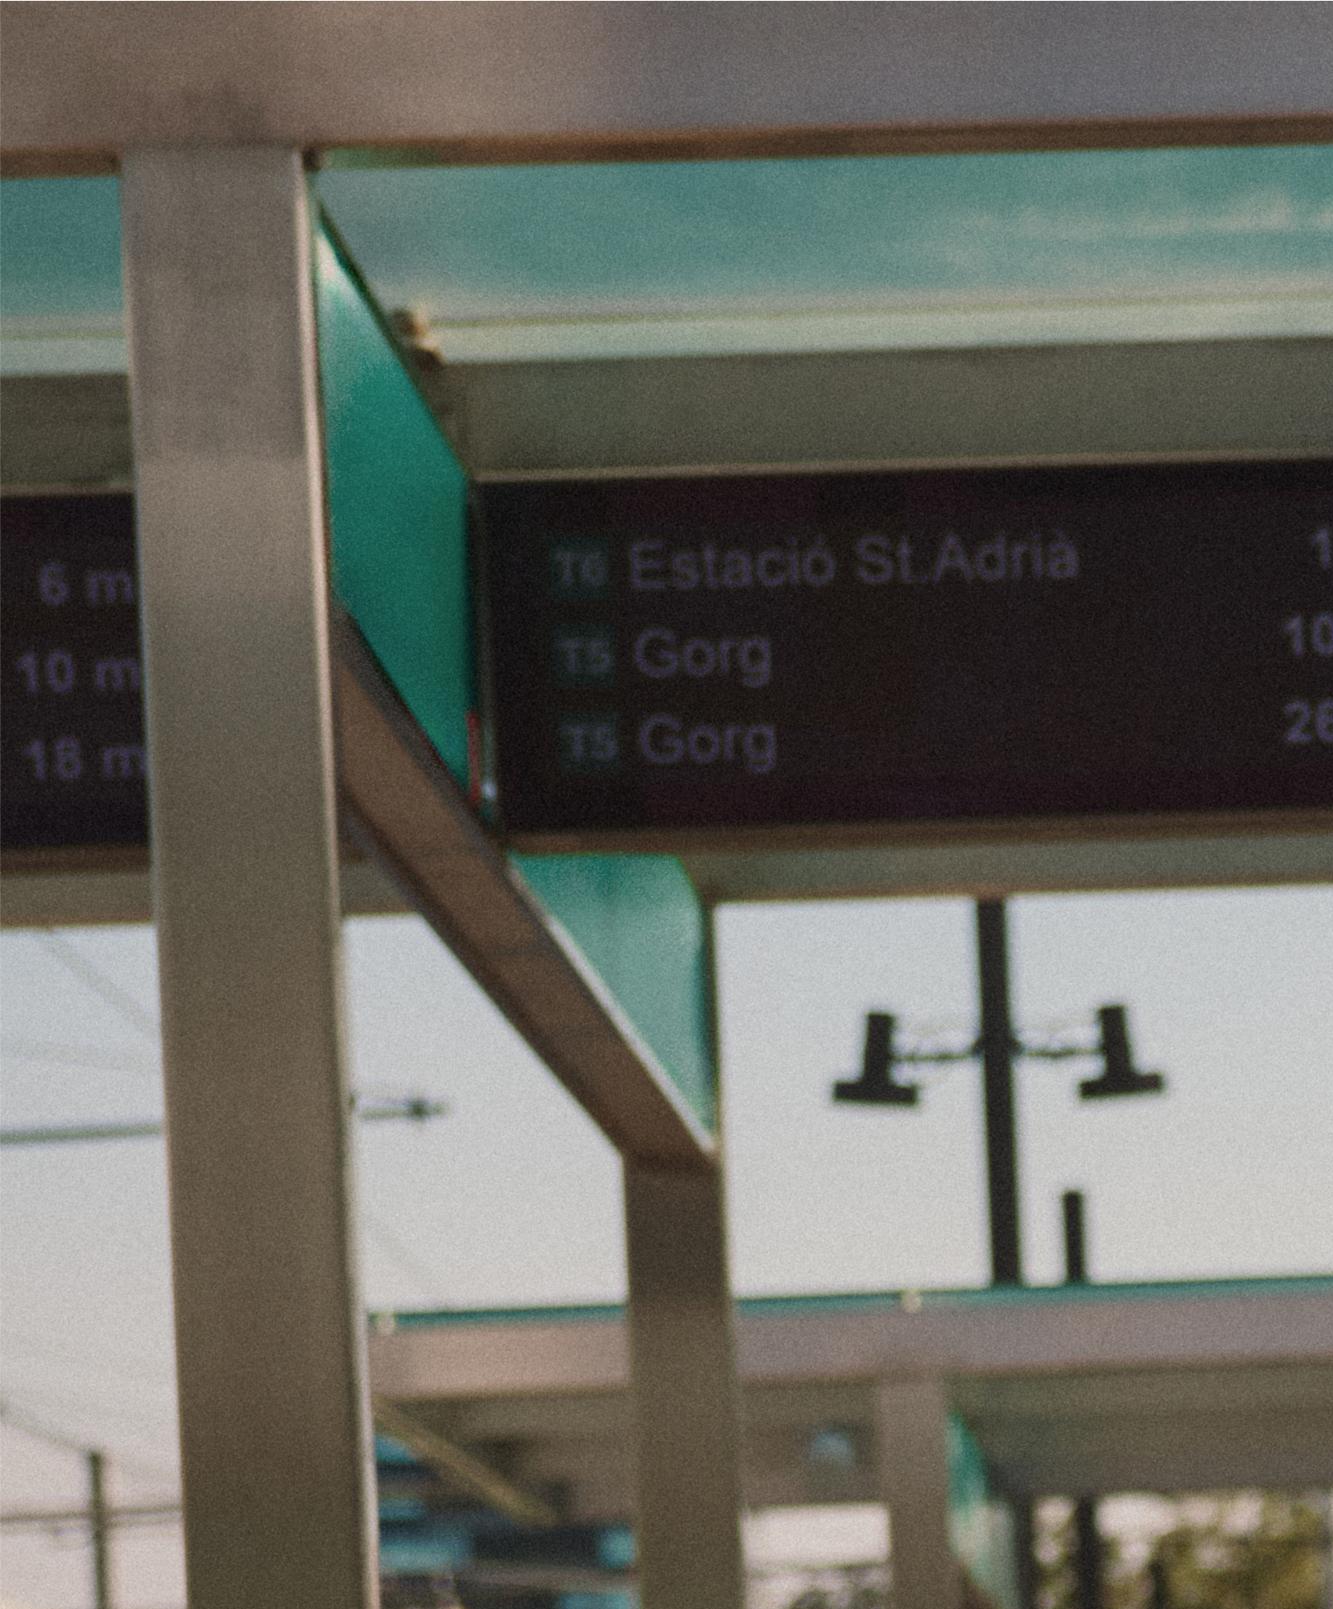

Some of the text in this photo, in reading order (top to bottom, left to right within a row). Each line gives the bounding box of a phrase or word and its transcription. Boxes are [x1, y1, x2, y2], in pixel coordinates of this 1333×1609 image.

[554, 546, 609, 589] T6
[629, 534, 836, 592] Estació
[1310, 524, 1333, 570] 1
[37, 560, 70, 607] 6
[14, 648, 77, 696] 10
[633, 627, 773, 689] Gorg
[638, 713, 778, 774] Gorg
